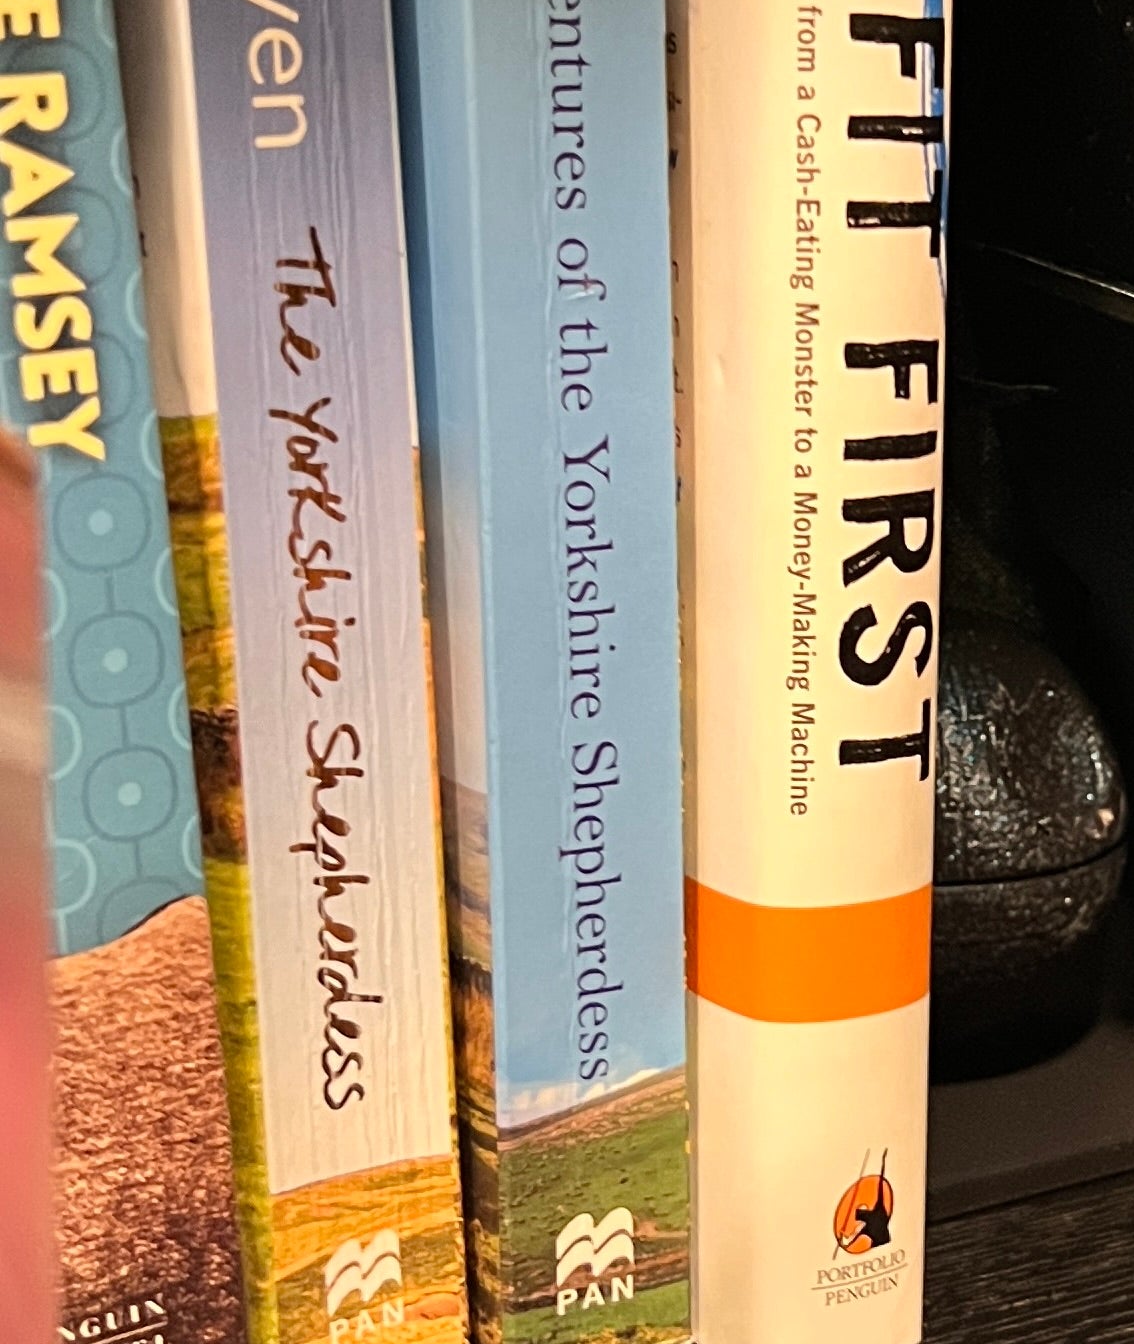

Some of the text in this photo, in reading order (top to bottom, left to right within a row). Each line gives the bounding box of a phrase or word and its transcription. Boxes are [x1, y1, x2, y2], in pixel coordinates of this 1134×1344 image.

[796, 5, 823, 73] from
[796, 85, 816, 101] a
[790, 113, 822, 291] Cash-Eating
[0, 70, 106, 462] RAMSEY
[556, 237, 608, 302] of
[559, 319, 610, 413] the
[794, 302, 820, 416] Monster
[793, 464, 812, 479] a
[794, 425, 818, 454] to
[562, 433, 616, 721] Yorkshire
[786, 491, 819, 693] Money-Making
[838, 339, 940, 782] FIRST
[267, 225, 384, 1112] The Yorkshire Shepherdess
[789, 702, 817, 817] Machine
[559, 740, 624, 1082] Shepherdess
[555, 1273, 635, 1315] PAN
[816, 1248, 907, 1285] PORTFOLIO
[824, 1273, 900, 1307] PENGUIN
[56, 1293, 169, 1342] NGUIN
